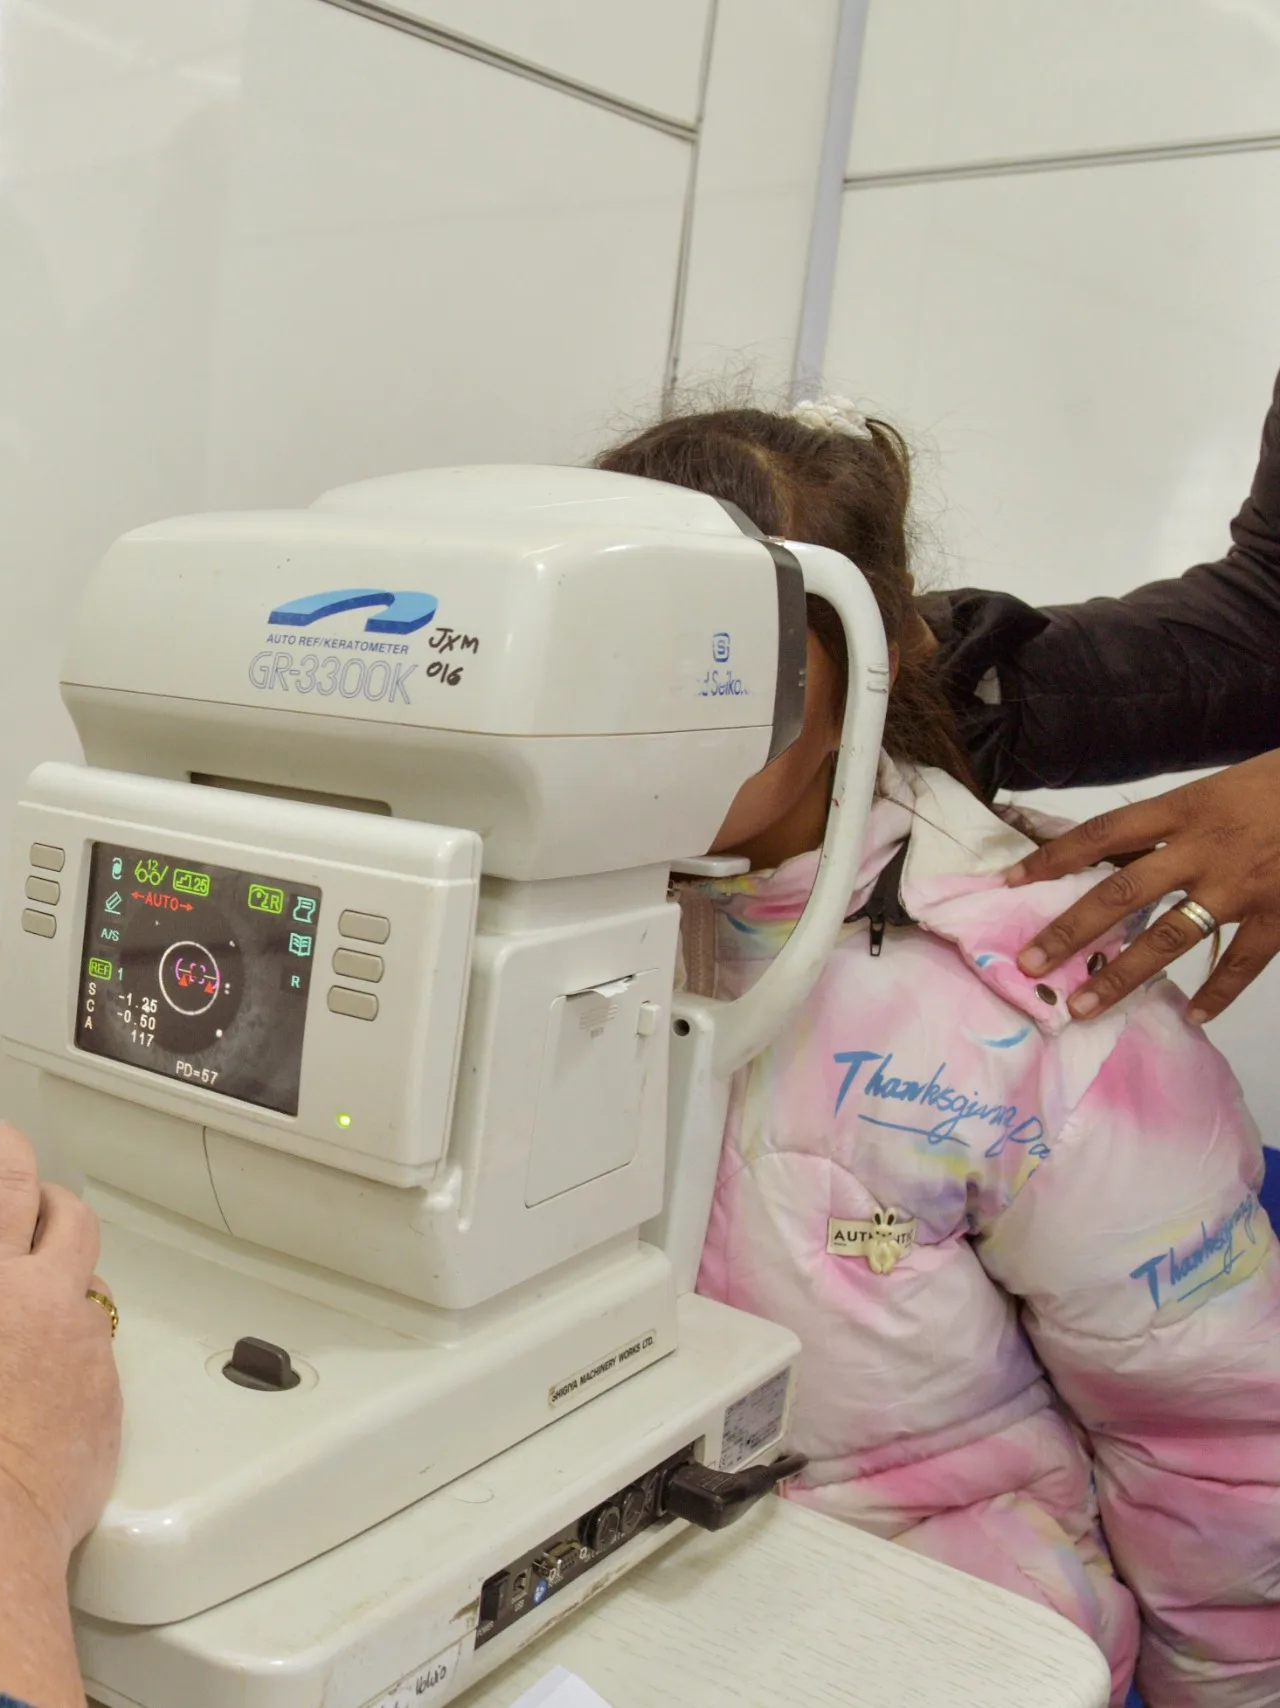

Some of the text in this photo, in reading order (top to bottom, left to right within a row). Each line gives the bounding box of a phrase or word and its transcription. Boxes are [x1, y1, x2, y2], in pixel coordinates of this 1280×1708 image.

[267, 633, 409, 655] AUTO REF/KERATOMETER
[428, 627, 479, 655] JXM
[248, 650, 419, 705] GR-3300K
[426, 660, 464, 687] 016
[148, 859, 159, 873] 12
[194, 876, 208, 893] 25
[145, 891, 180, 912] AUTO
[100, 928, 120, 942] A/S
[90, 959, 111, 979] REF
[88, 981, 97, 996] S
[291, 975, 301, 989] R
[86, 998, 95, 1013] C
[84, 1015, 155, 1048] A 117
[175, 1060, 219, 1085] PD=57
[579, 1356, 617, 1385] MACHINERY
[618, 1343, 641, 1362] WORKS
